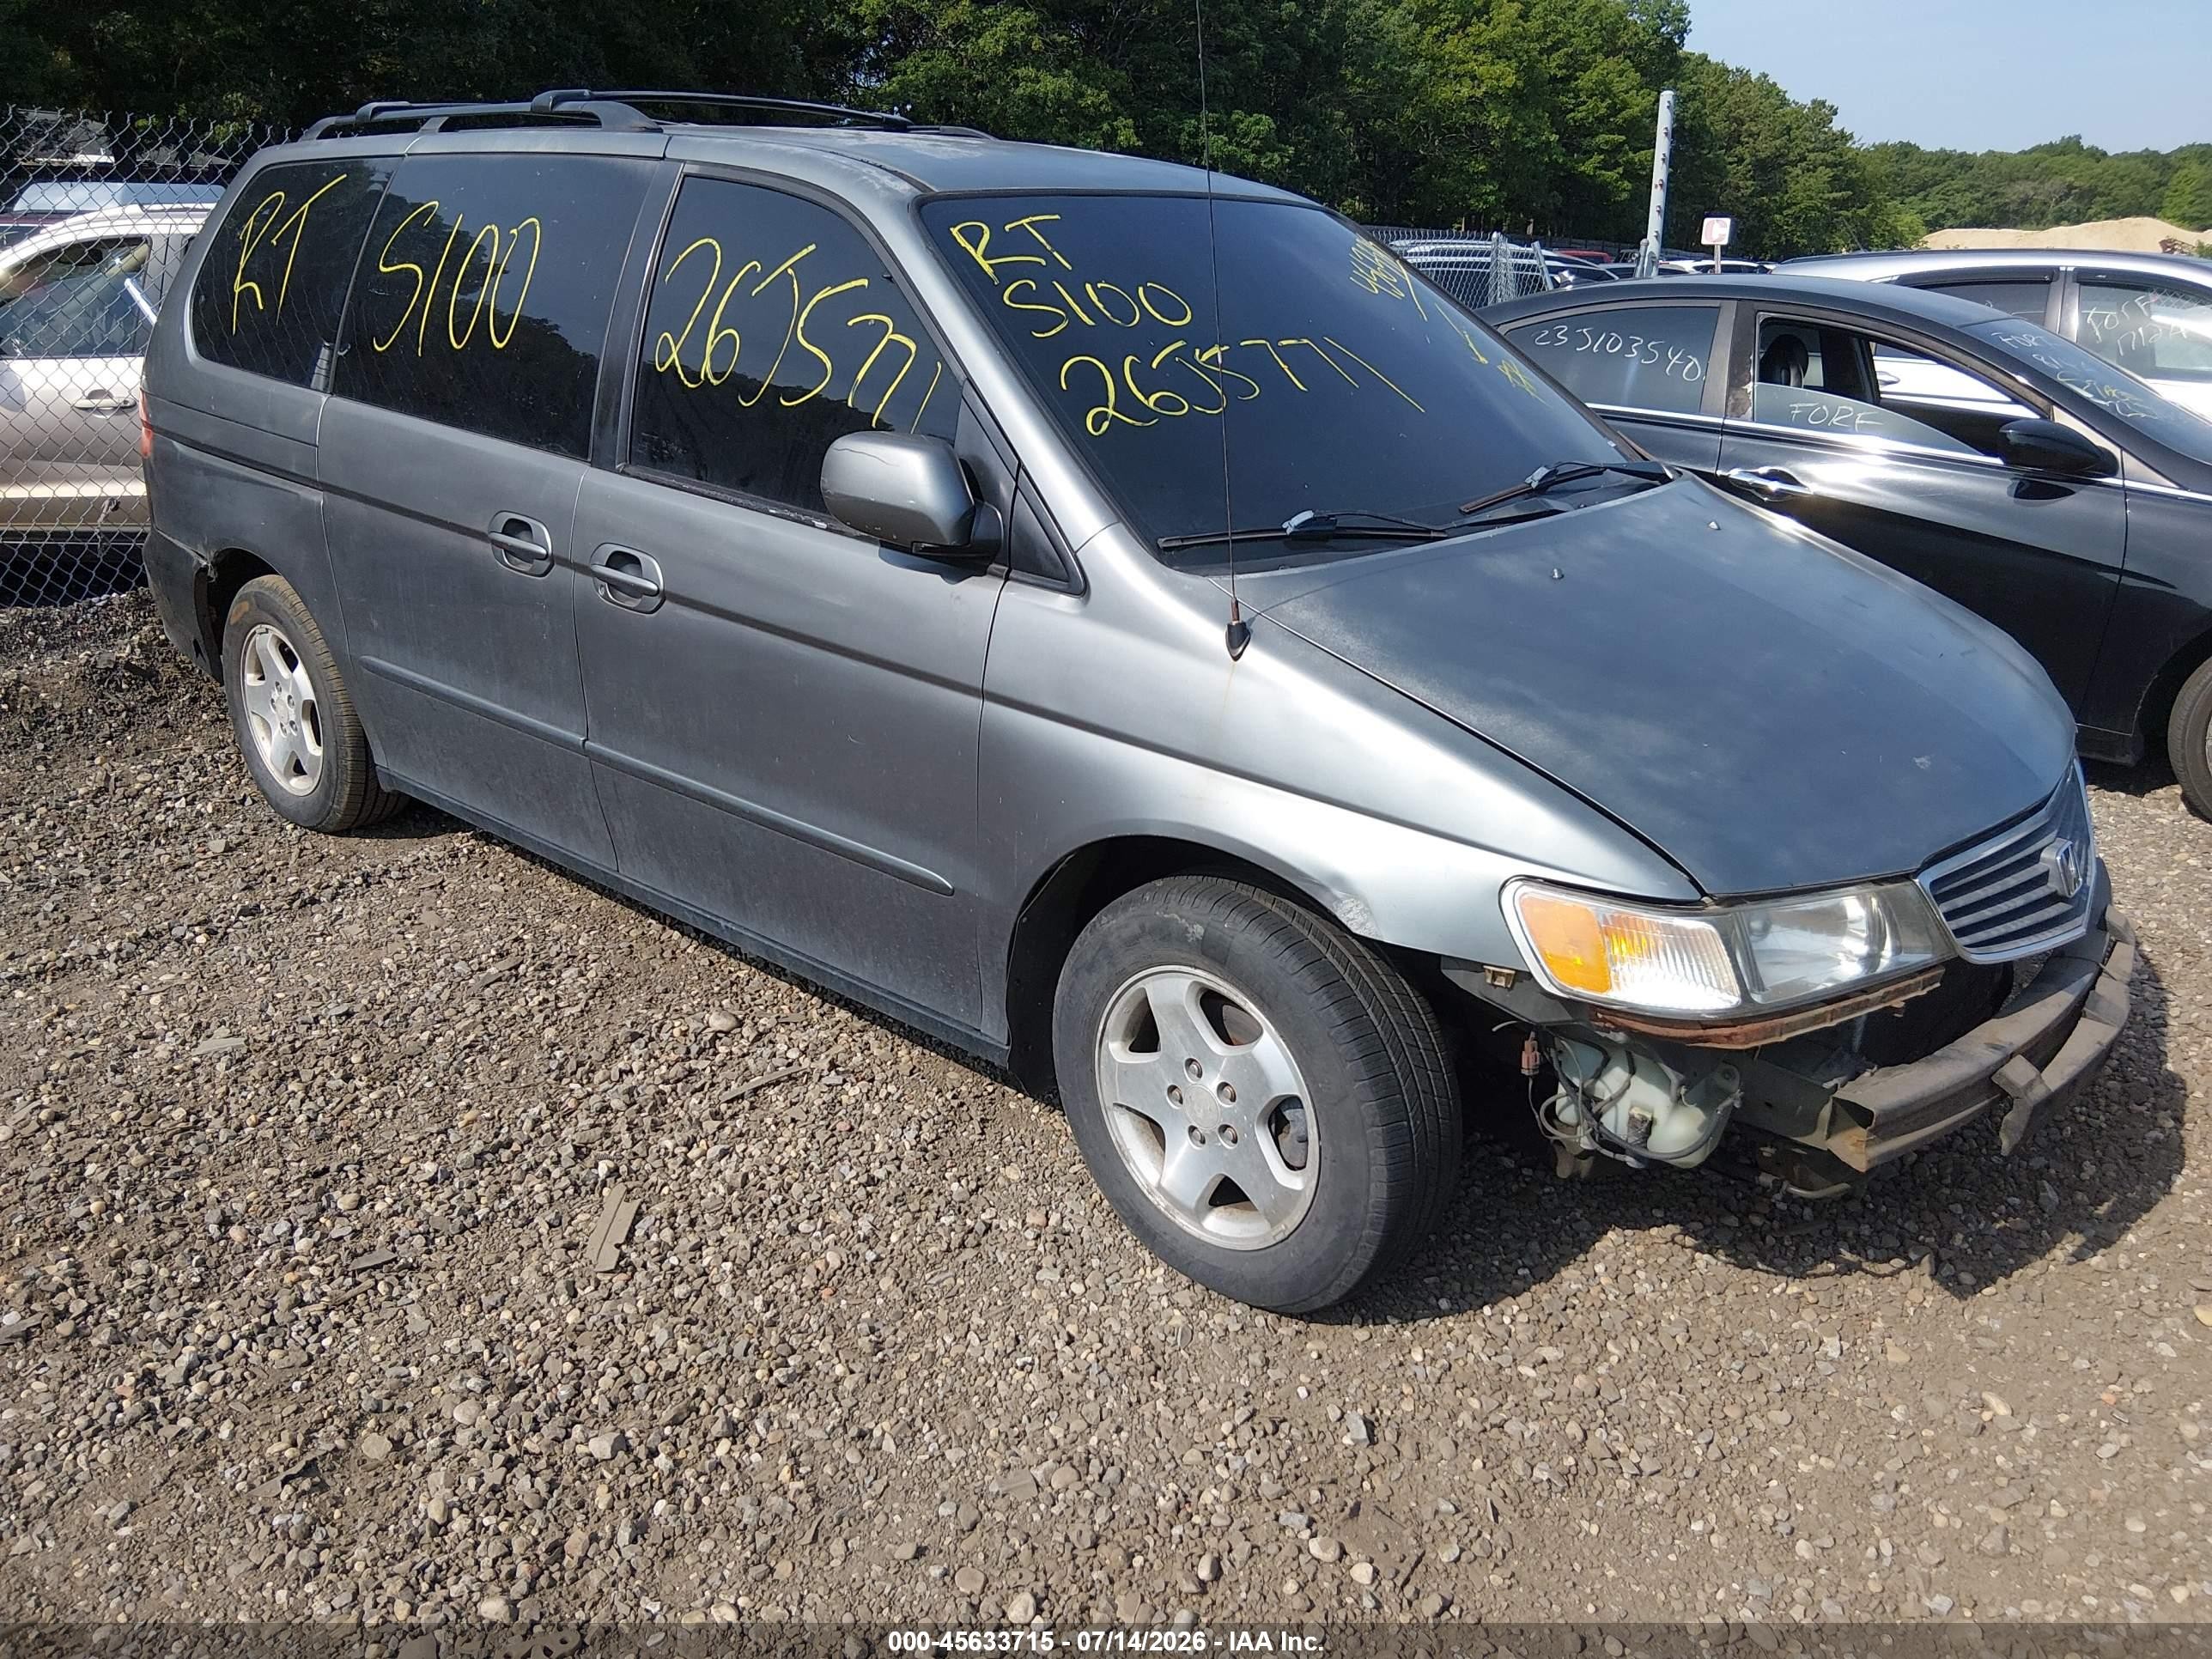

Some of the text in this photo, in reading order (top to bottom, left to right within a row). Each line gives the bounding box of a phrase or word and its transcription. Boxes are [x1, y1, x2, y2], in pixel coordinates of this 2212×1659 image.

[233, 173, 349, 337] RT
[372, 199, 542, 357] S100
[950, 213, 1073, 286] RT
[1002, 278, 1193, 338] S100
[1060, 335, 1425, 438] 26J5771
